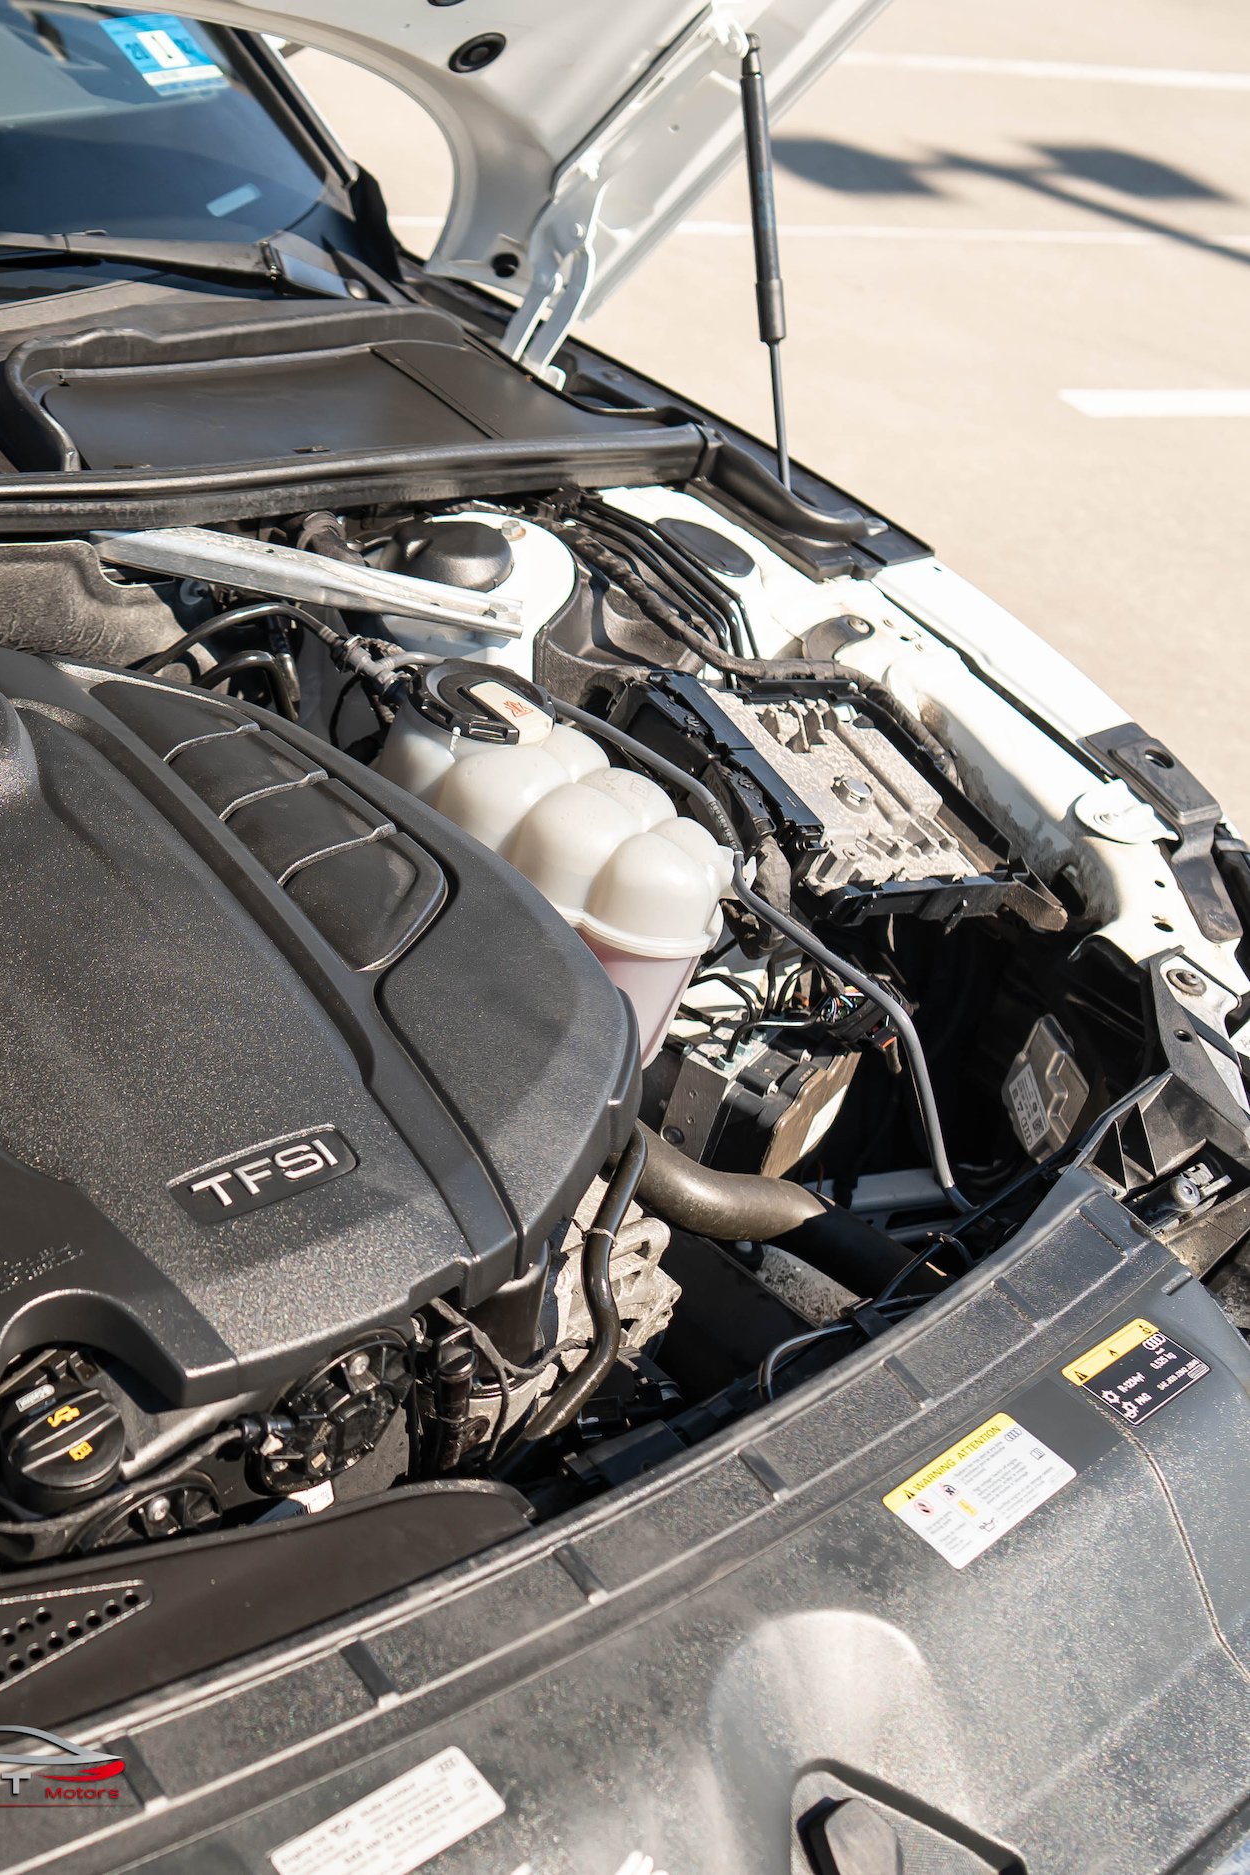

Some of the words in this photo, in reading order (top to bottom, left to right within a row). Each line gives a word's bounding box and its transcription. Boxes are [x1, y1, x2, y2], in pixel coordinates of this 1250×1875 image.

[190, 1138, 339, 1207] TFSI
[1134, 1392, 1152, 1405] PAG
[913, 1458, 957, 1491] WARNING
[957, 1424, 1002, 1459] ATTENTION
